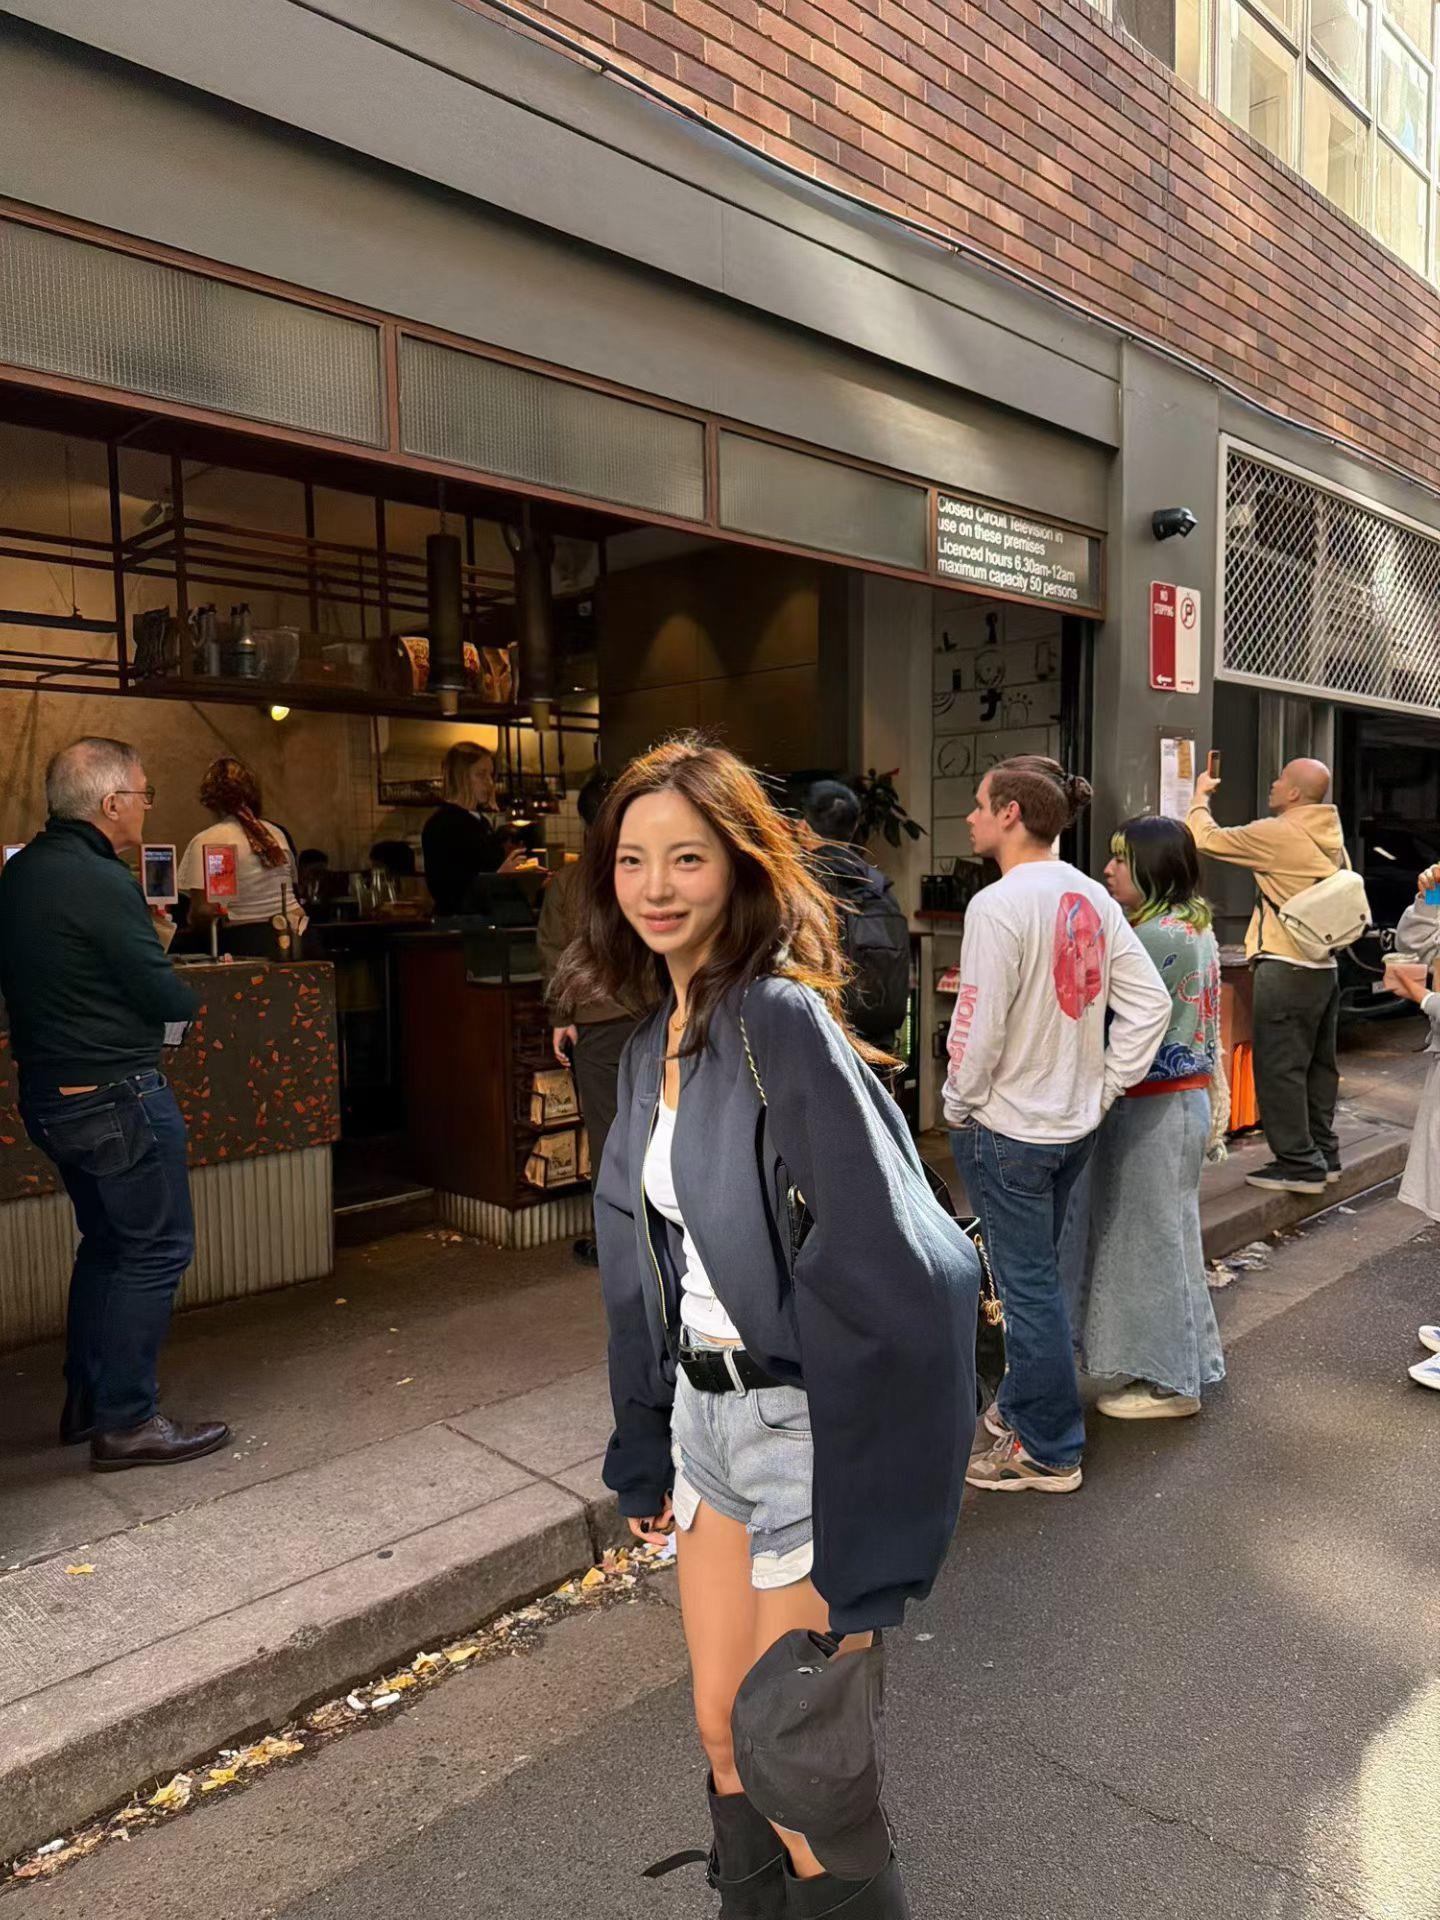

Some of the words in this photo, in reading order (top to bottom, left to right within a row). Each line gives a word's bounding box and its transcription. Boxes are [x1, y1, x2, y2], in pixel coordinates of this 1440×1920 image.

[938, 496, 974, 520] Closed
[975, 507, 1007, 529] Circuit
[1010, 515, 1053, 541] Television
[1055, 530, 1064, 544] in
[938, 518, 957, 533] use
[959, 522, 973, 537] on
[974, 523, 1002, 545] these
[1004, 534, 1046, 556] premises
[938, 537, 984, 561] Licenced
[985, 547, 1013, 569] hours
[1014, 555, 1076, 583] 6.30am-12am
[938, 558, 987, 580] maximum
[989, 569, 1029, 592] capacity
[1030, 576, 1042, 592] 50
[1043, 582, 1078, 600] persons
[1160, 590, 1169, 602] NO
